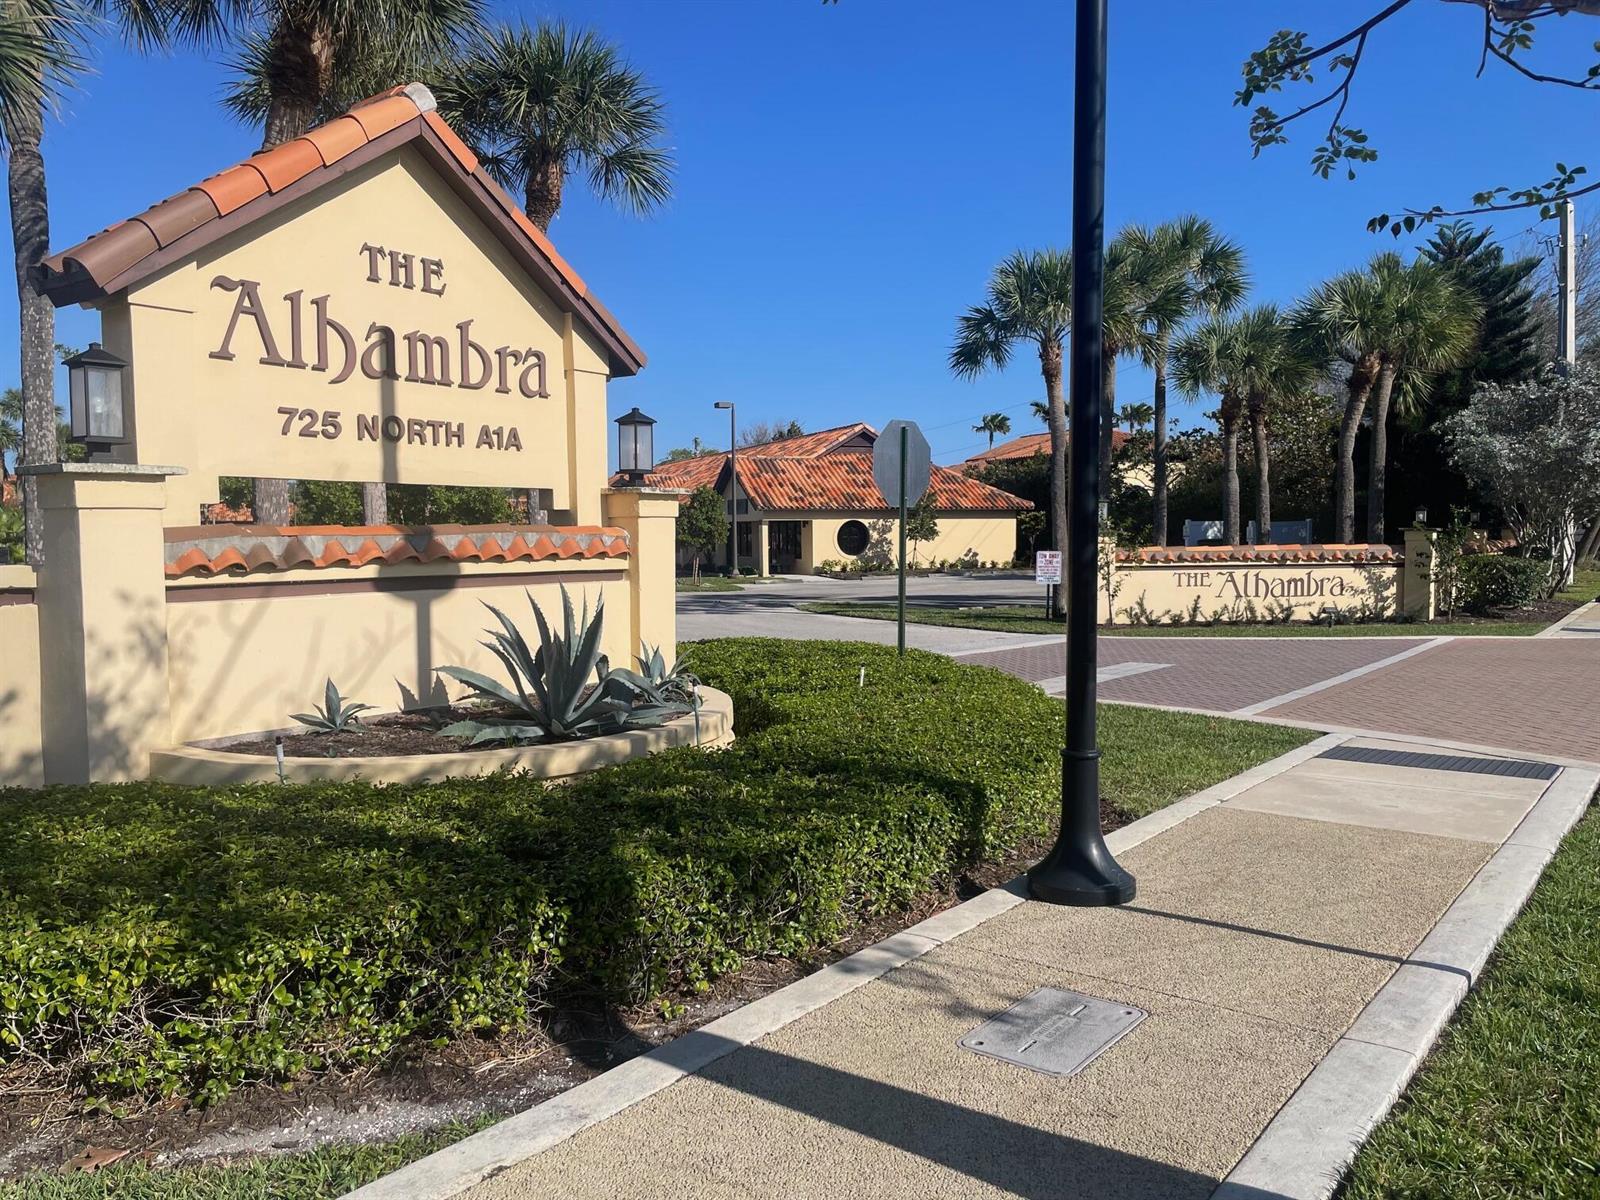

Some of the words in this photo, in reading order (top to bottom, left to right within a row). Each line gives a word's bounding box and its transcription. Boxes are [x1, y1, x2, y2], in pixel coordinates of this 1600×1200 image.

[359, 242, 447, 297] THE
[208, 275, 551, 399] Alhambra
[277, 406, 342, 440] 725
[357, 413, 465, 448] NORTH
[476, 424, 523, 451] A1A
[1173, 572, 1212, 587] THE
[1215, 570, 1344, 601] Alhambra
